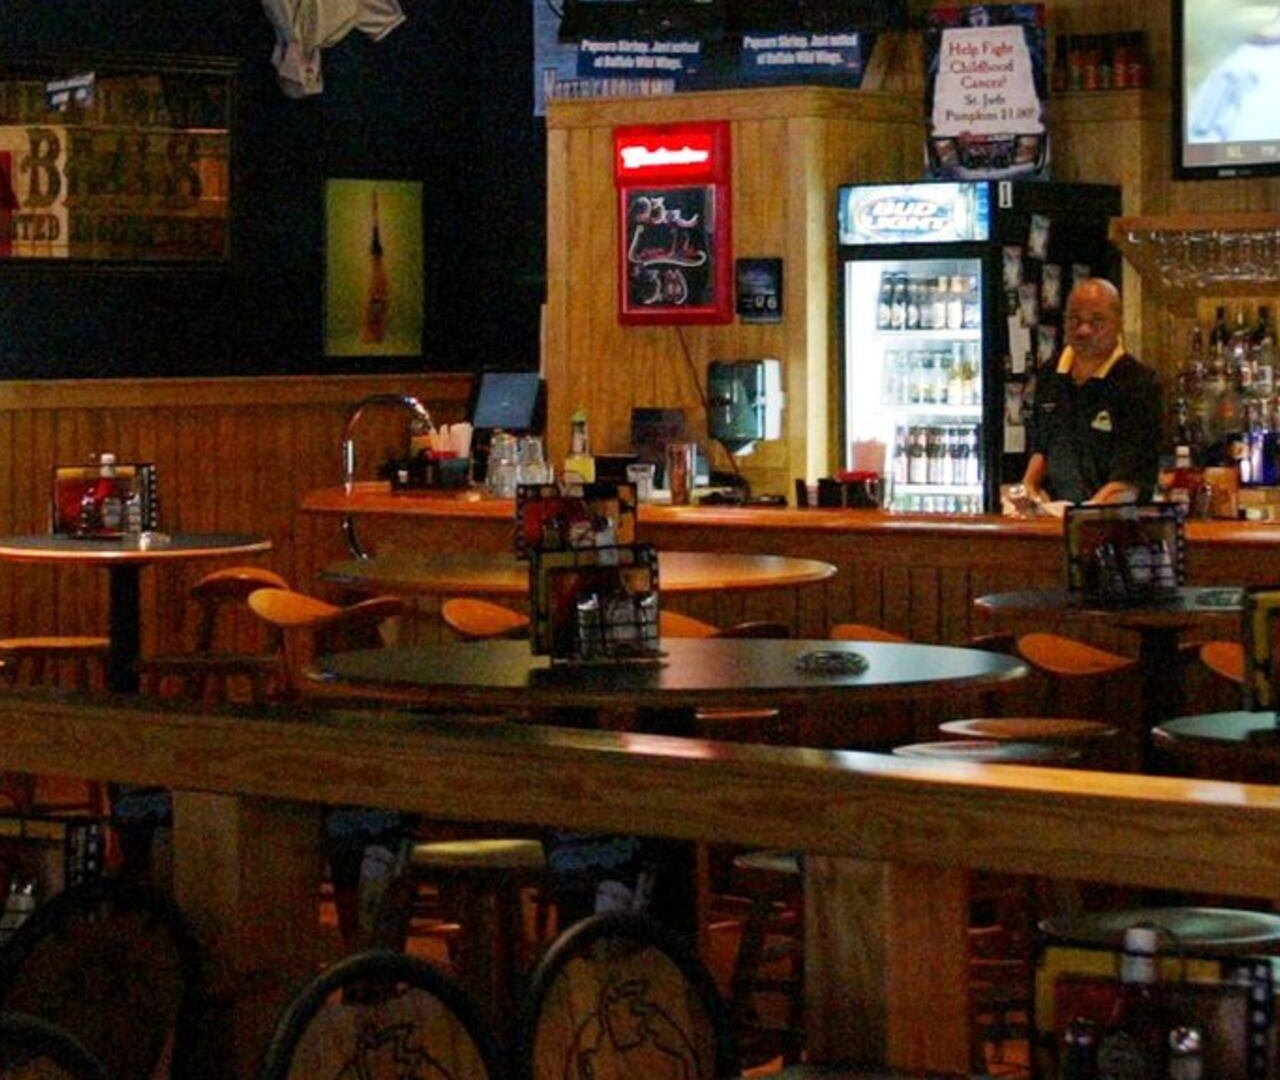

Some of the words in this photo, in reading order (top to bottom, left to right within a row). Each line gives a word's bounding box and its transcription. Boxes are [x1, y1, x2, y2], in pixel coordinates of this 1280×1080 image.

[948, 41, 979, 58] Help
[950, 59, 1014, 74] Childhood
[871, 201, 938, 217] BUD
[870, 216, 949, 231] LIGHT
